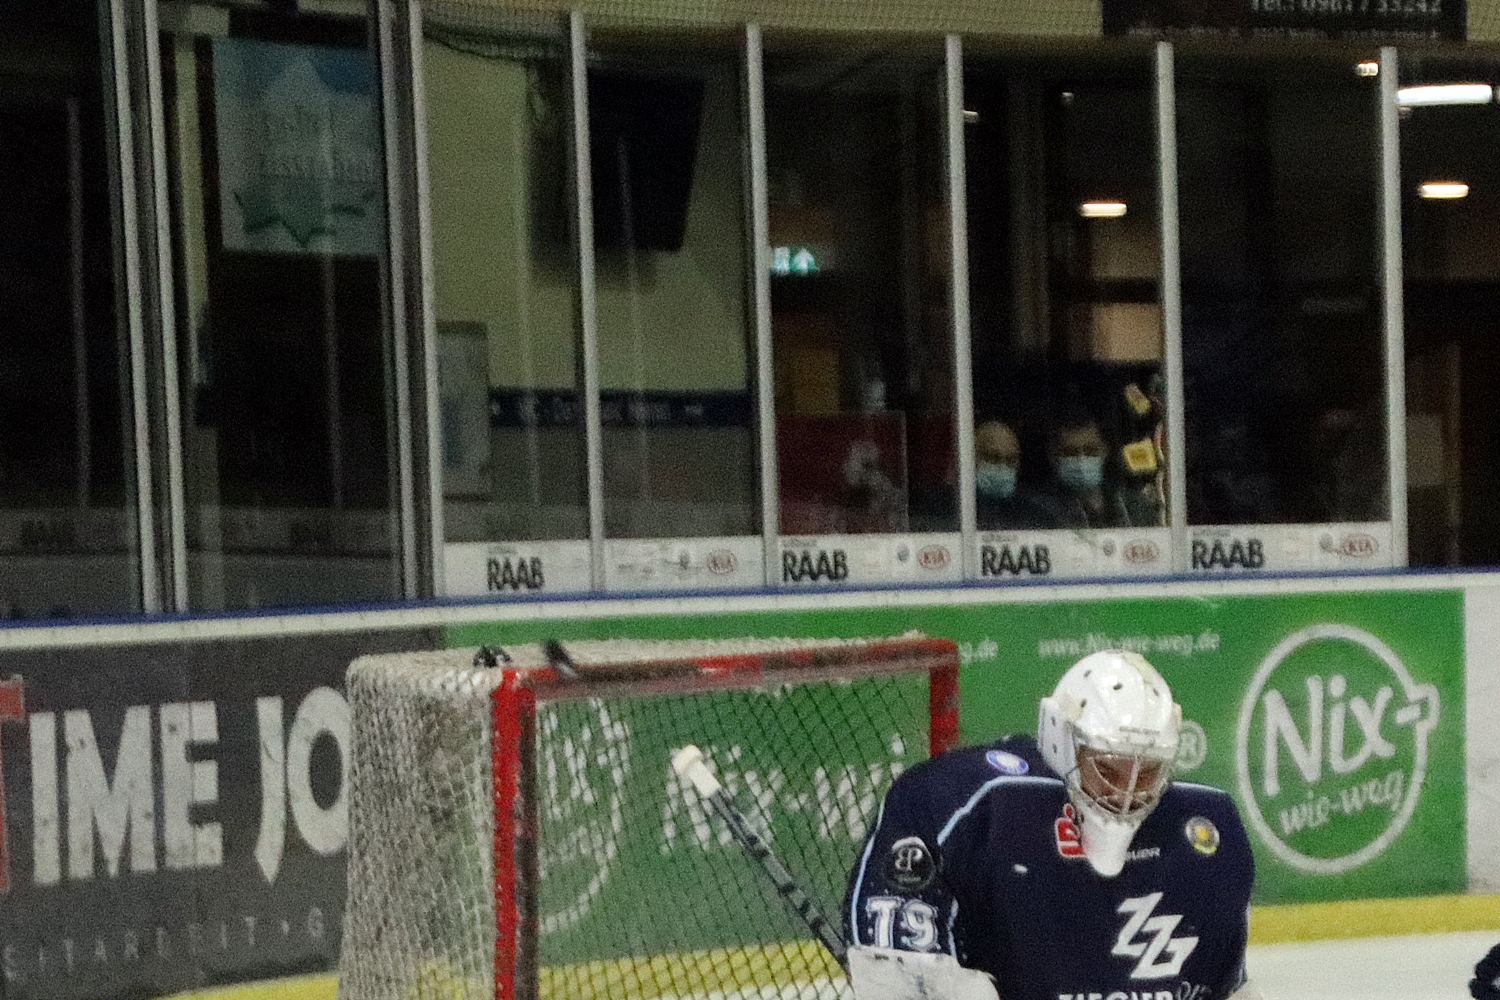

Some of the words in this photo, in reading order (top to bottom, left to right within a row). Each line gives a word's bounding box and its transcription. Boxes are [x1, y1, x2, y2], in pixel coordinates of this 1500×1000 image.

[783, 548, 849, 582] RAAB
[980, 543, 1051, 577] RAAB
[1192, 537, 1265, 570] RAAB
[486, 556, 546, 591] RAAB
[1264, 675, 1421, 798] Nix-
[0, 674, 224, 894] IME
[254, 685, 351, 886] JO
